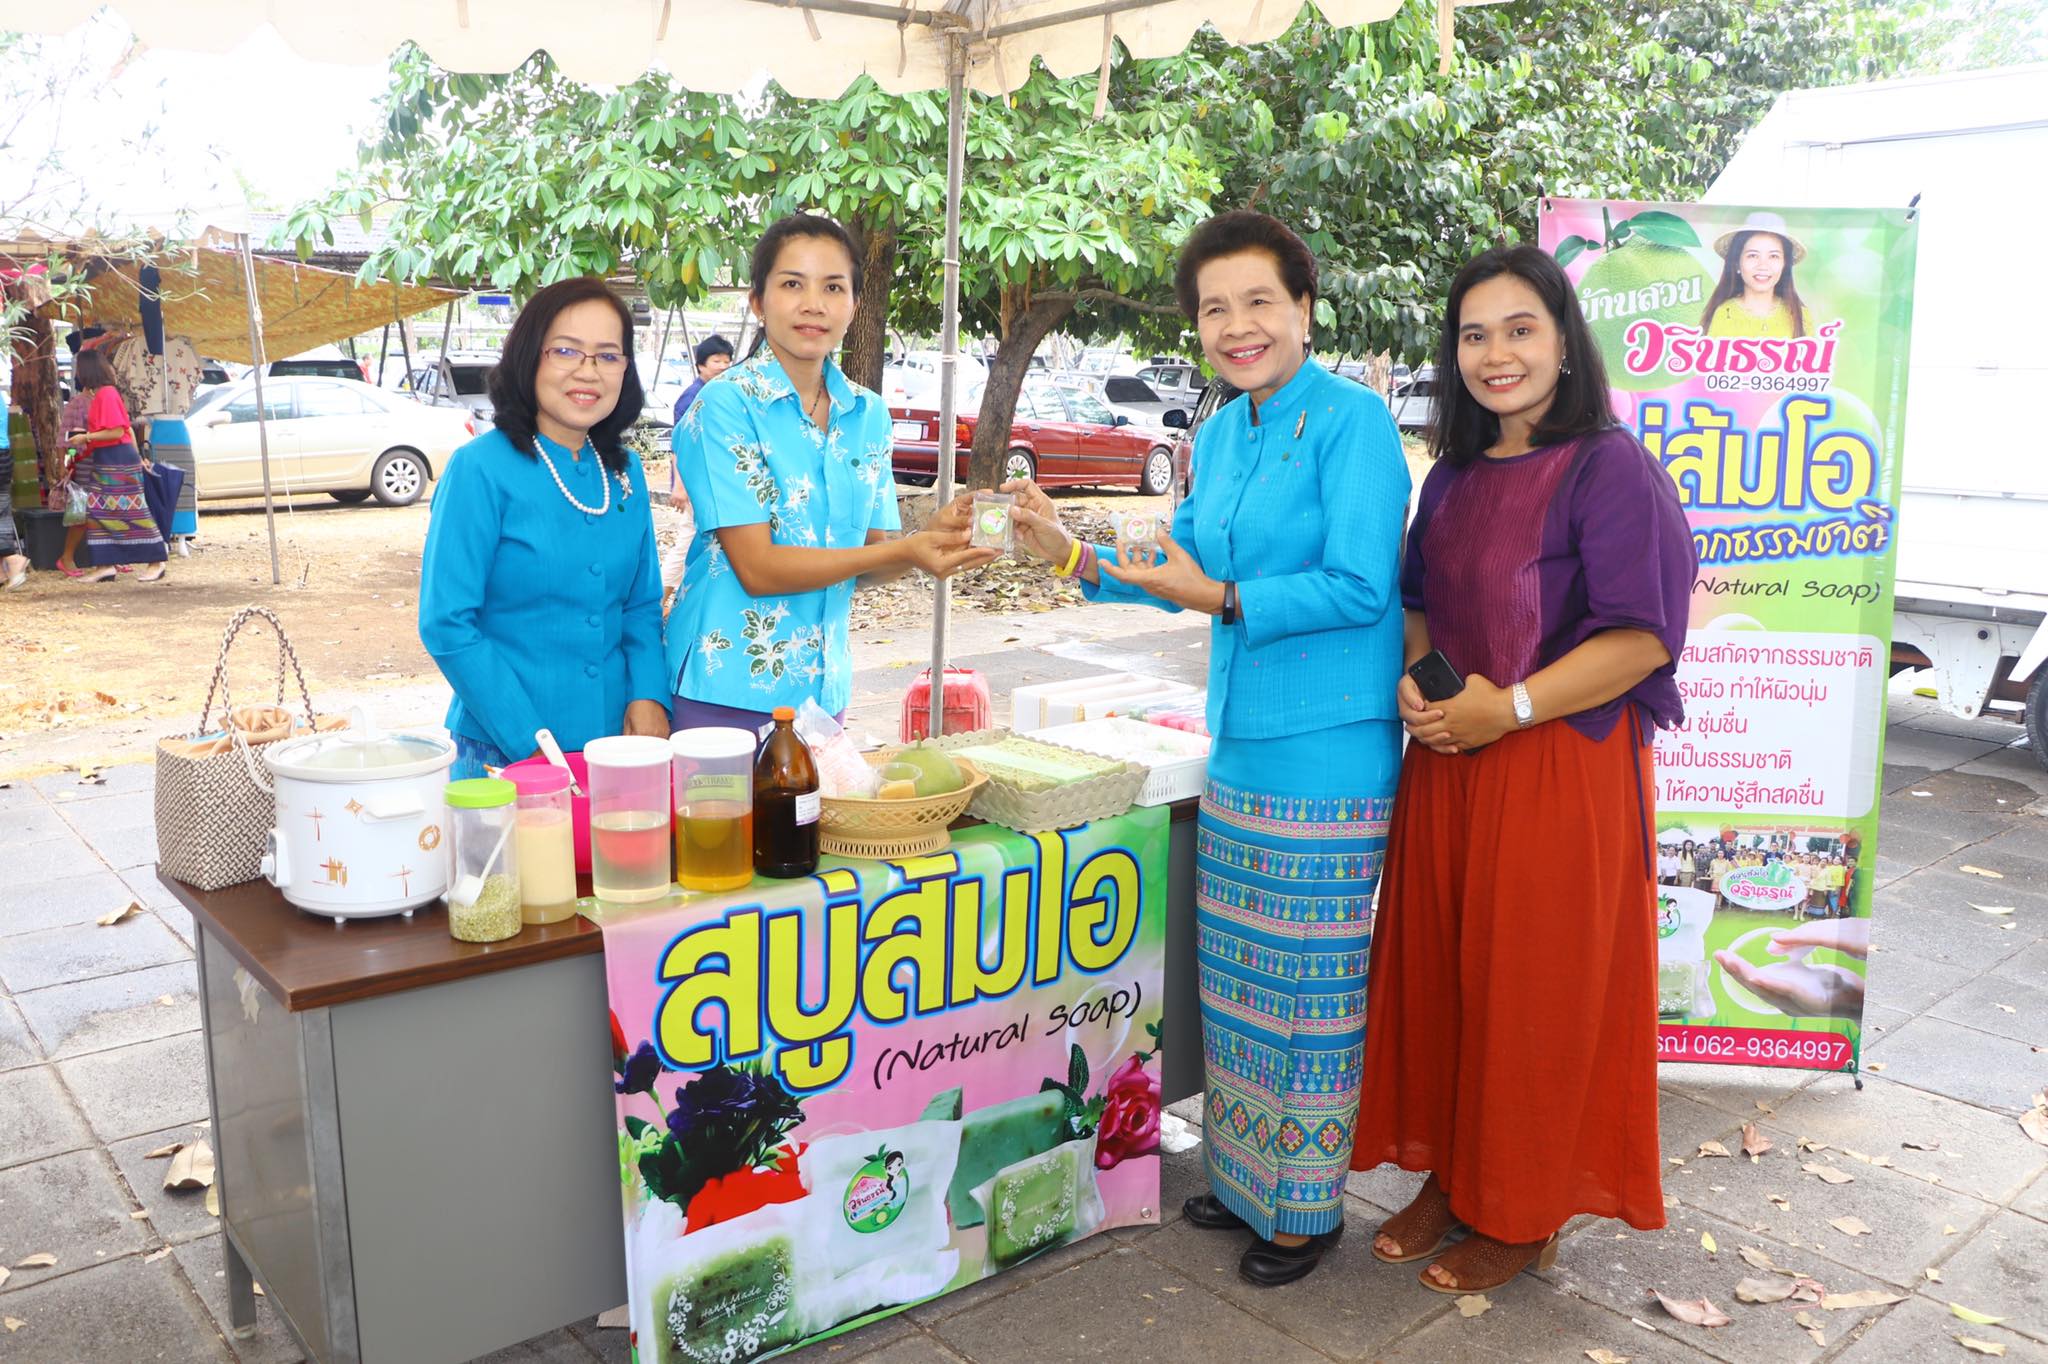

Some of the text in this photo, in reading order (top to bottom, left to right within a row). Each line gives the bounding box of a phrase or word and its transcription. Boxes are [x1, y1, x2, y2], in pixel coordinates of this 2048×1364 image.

[1579, 276, 1702, 324] บ้านสวน
[1706, 374, 1830, 391] 062-9364997
[1694, 504, 1889, 560] ากธรรมชาติ
[1692, 576, 1881, 605] Natural Soap)
[1681, 643, 1873, 668] สมสกัดจากธรรมชาติ
[1678, 676, 1828, 707] รุงผิว ทำให้ผิวนุ่ม
[1697, 706, 1748, 740] ชุ่มชื่น
[1653, 739, 1793, 770] ลิ่นเป็นธรรมชาติ
[1665, 778, 1825, 810] ให้ความรู้สึกสดชื่น
[873, 981, 1142, 1090] (Natural Soap)
[1693, 1034, 1847, 1062] 062-9364997
